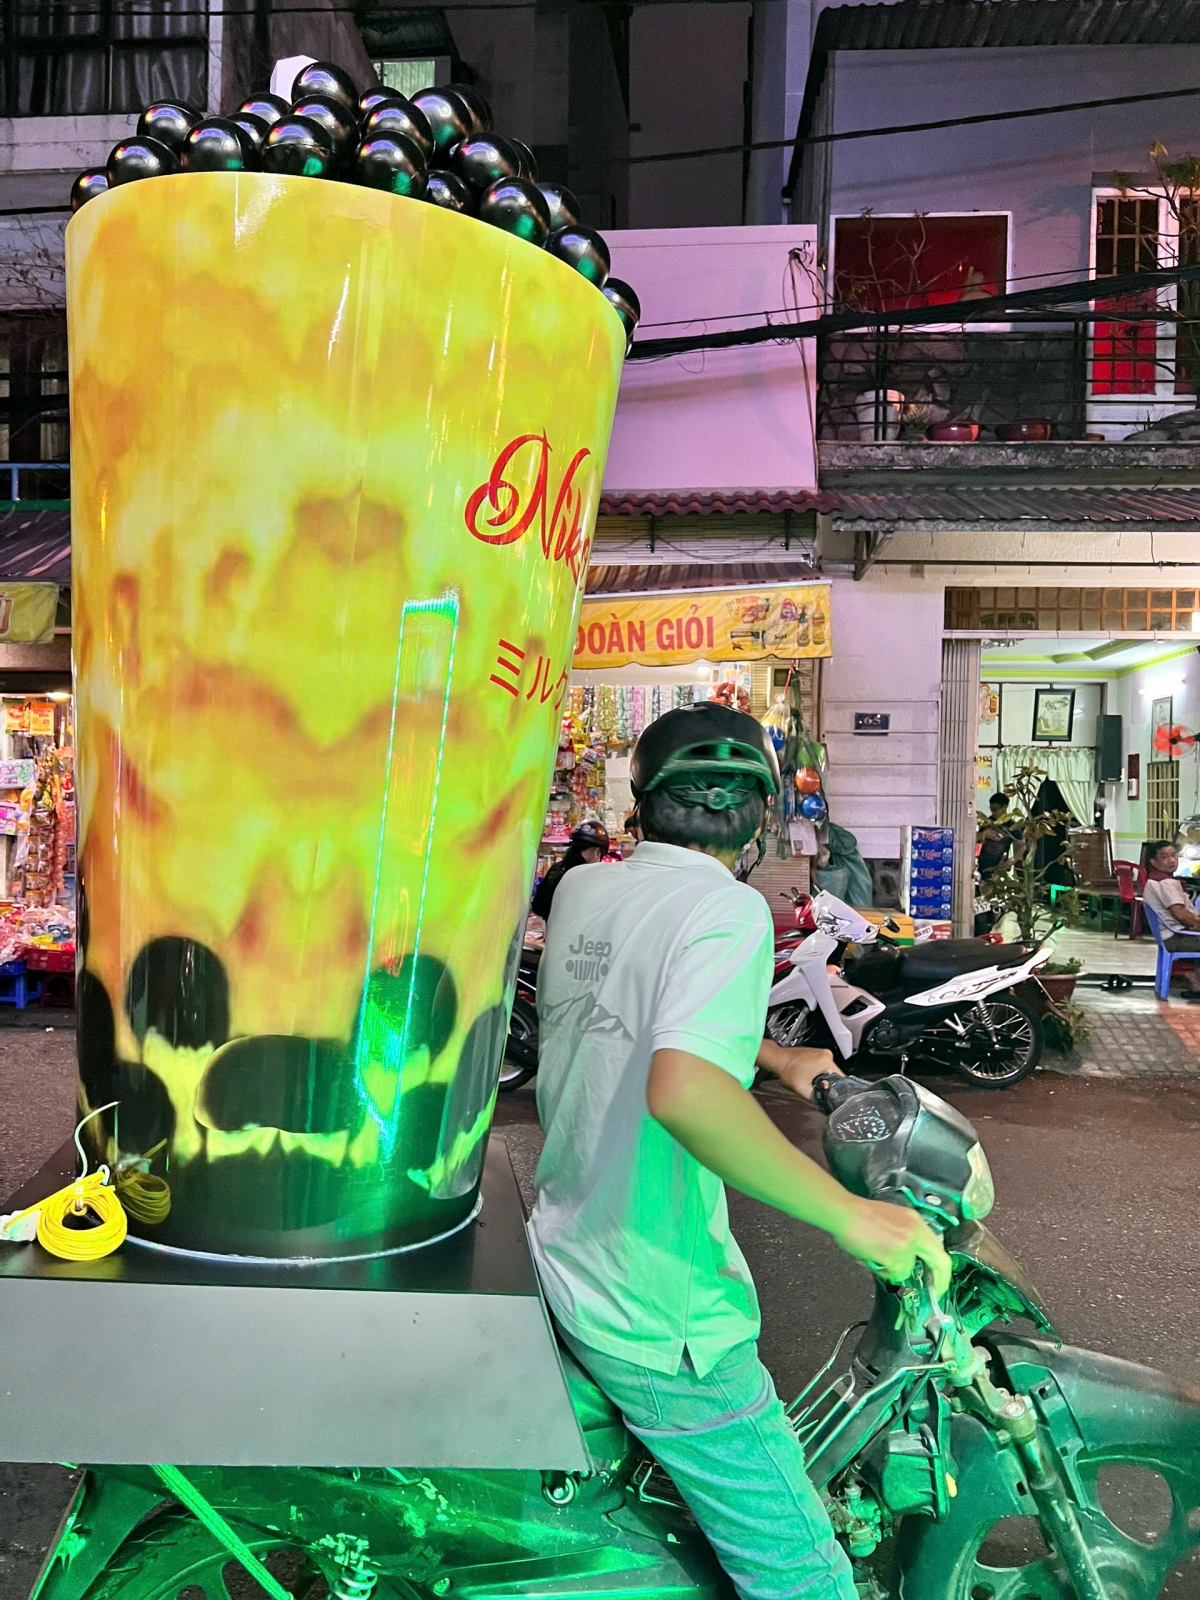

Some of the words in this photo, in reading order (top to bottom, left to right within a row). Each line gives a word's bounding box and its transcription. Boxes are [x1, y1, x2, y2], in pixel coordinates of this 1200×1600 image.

[656, 604, 714, 651] GIỎI
[919, 849, 942, 860] Tiger
[919, 867, 941, 879] Tiger
[918, 886, 941, 898] Tiger
[918, 905, 940, 916] Tiger
[569, 934, 612, 961] Jeep
